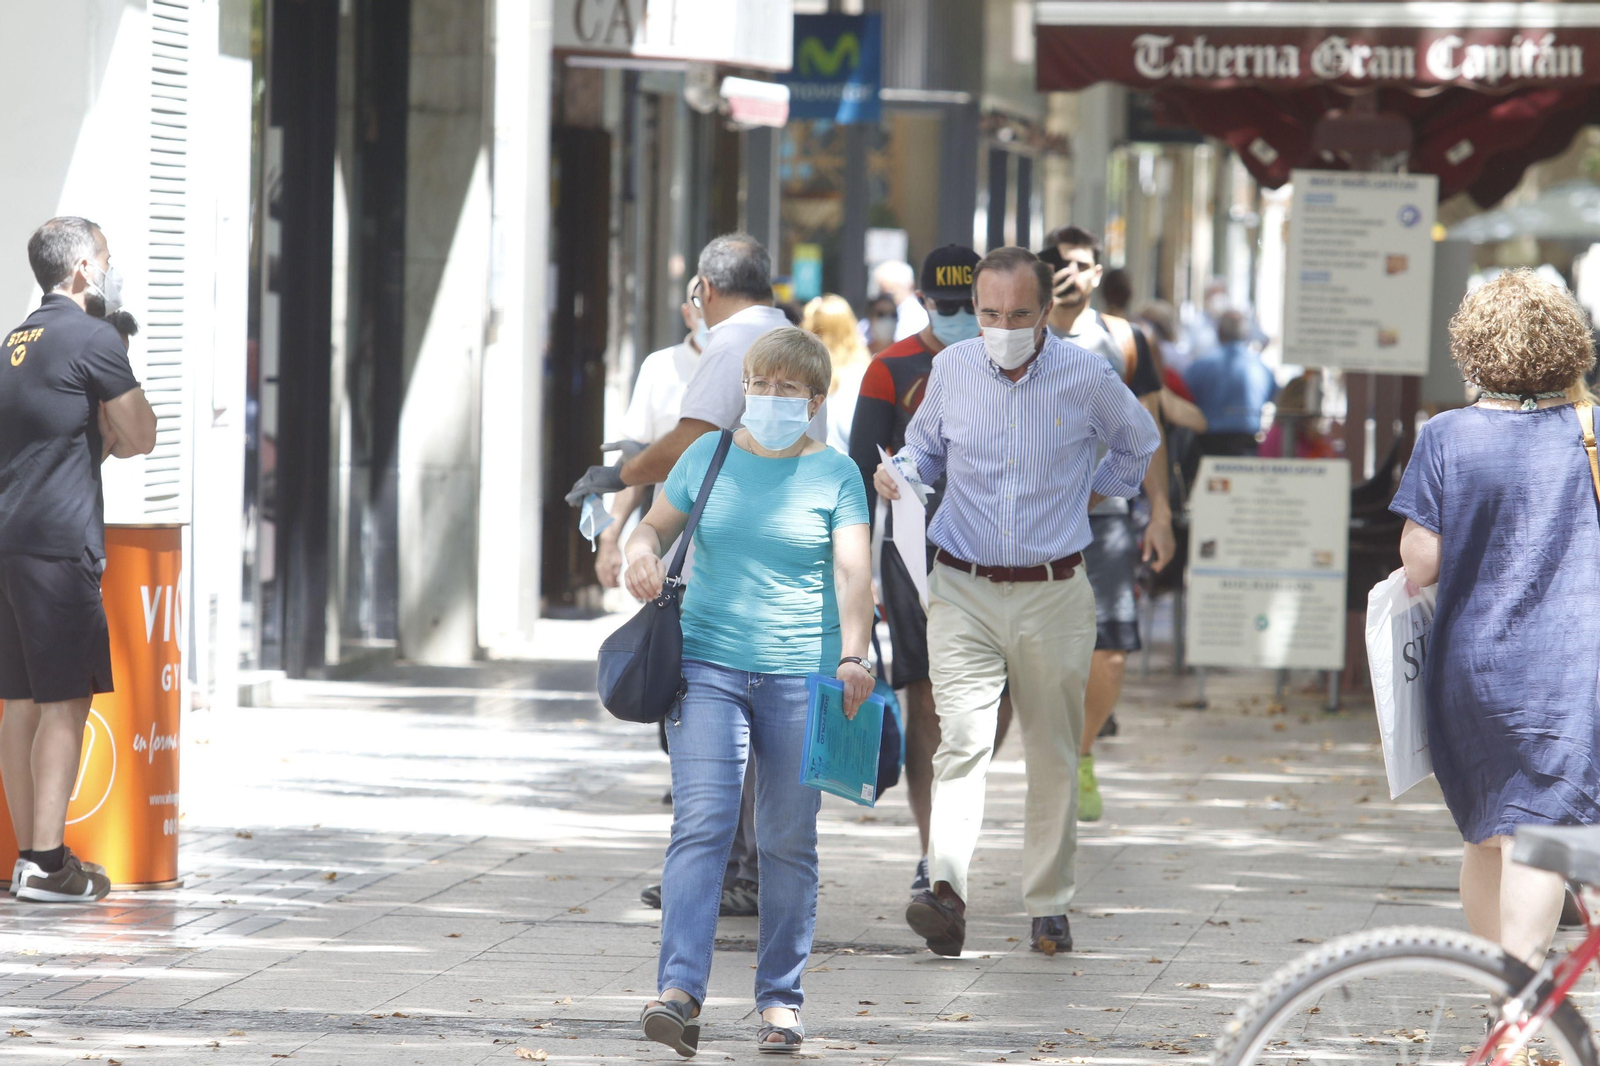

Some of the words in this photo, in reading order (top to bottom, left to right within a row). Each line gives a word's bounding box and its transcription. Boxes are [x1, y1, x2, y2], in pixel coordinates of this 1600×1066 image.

[1131, 34, 1301, 79] Taberna
[1310, 35, 1416, 79] Gran
[1425, 33, 1585, 82] Capitán
[936, 265, 973, 286] KING
[7, 328, 45, 347] STAFF
[161, 663, 181, 692] GY
[133, 733, 147, 753] en
